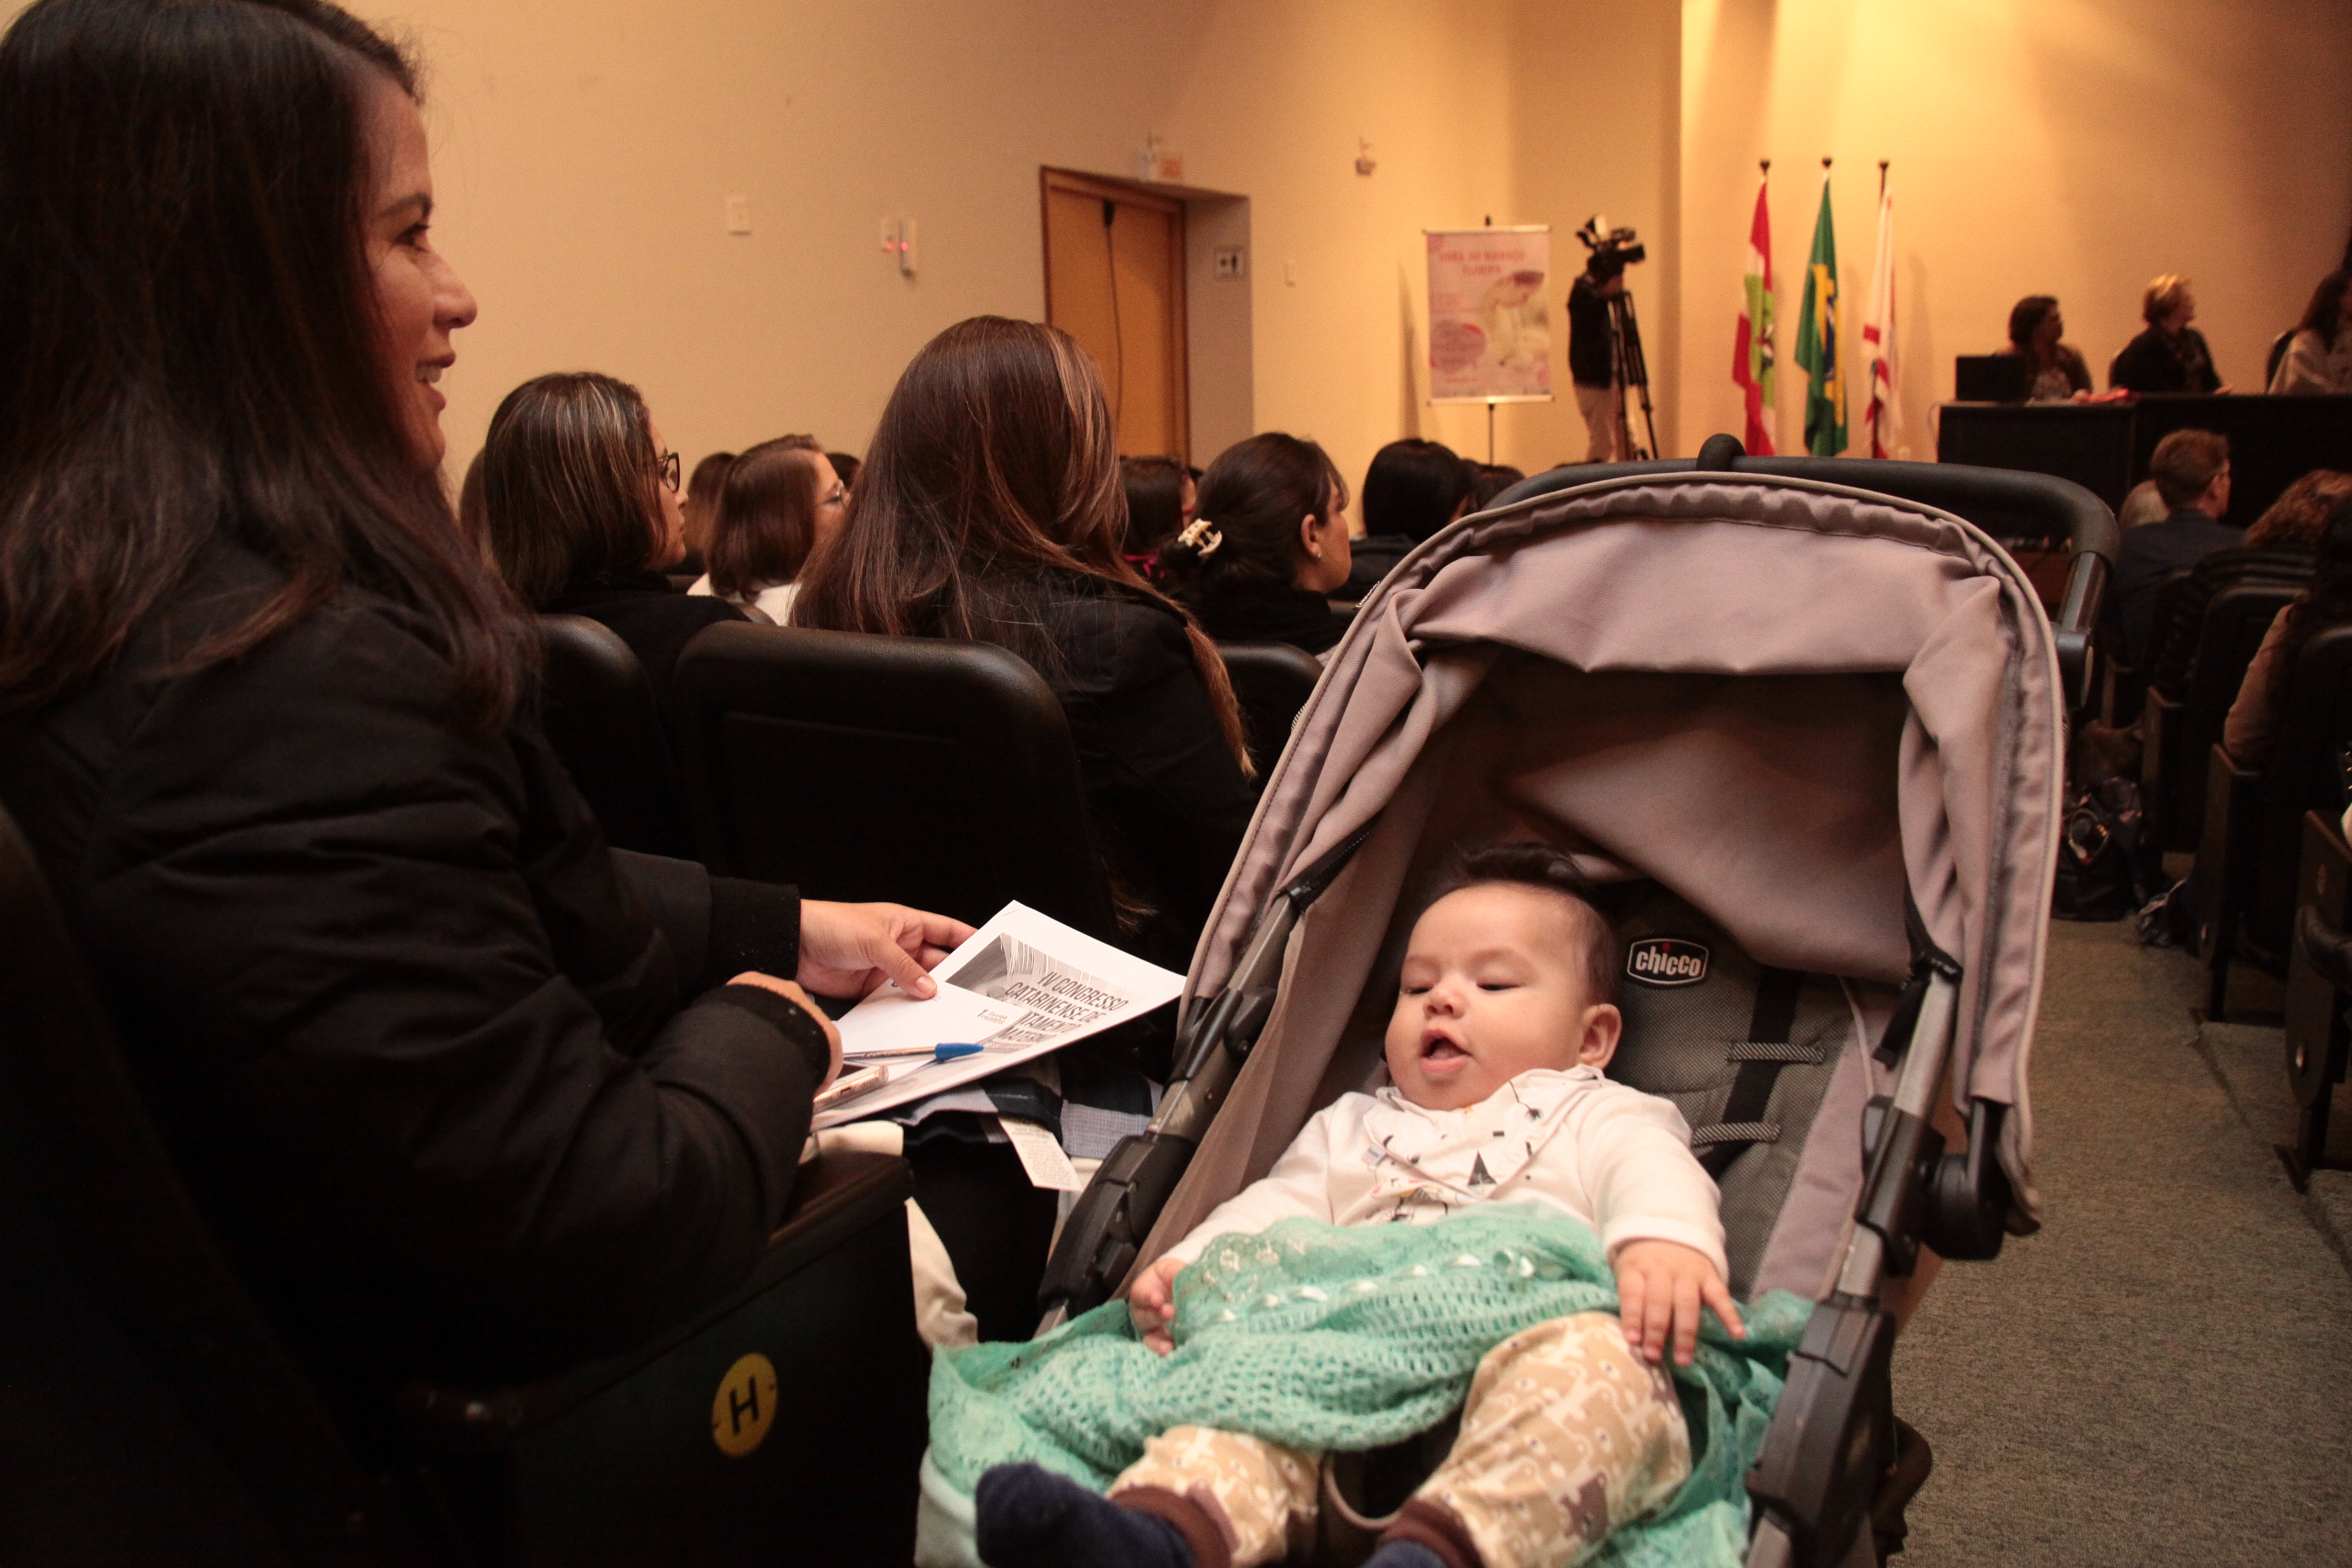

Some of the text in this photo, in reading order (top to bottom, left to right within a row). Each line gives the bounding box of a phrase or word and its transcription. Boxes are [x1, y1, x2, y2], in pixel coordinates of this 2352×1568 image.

[1636, 943, 1702, 977] chicco
[1004, 982, 1107, 1023] CATARINENSE DE
[1037, 971, 1129, 1011] IV CONGRESSO
[1016, 1010, 1081, 1033] ITAMENTO
[729, 1376, 760, 1435] H
